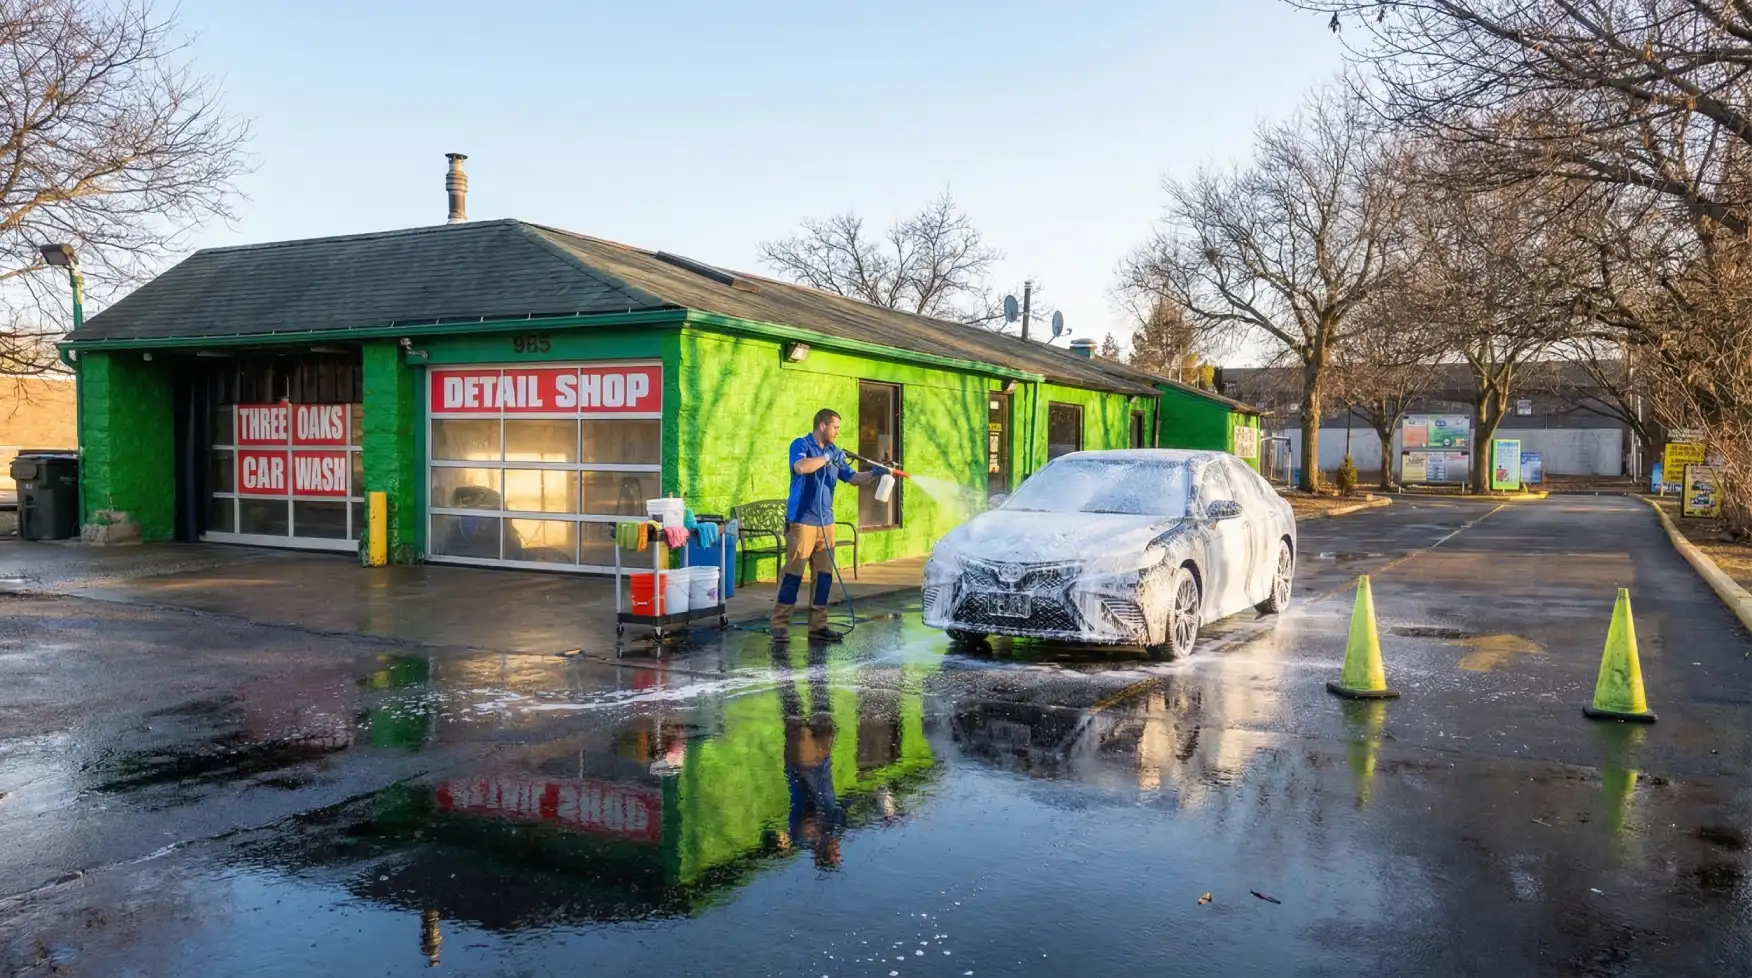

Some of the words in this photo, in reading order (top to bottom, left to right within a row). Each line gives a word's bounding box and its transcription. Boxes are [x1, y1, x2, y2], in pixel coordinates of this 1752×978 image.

[513, 336, 551, 353] 985
[444, 375, 543, 408] DETAIL
[555, 373, 649, 408] SHOP
[240, 407, 288, 440] THREE
[297, 405, 344, 440] OAKS
[242, 456, 284, 489] CAR
[294, 457, 346, 491] WASH
